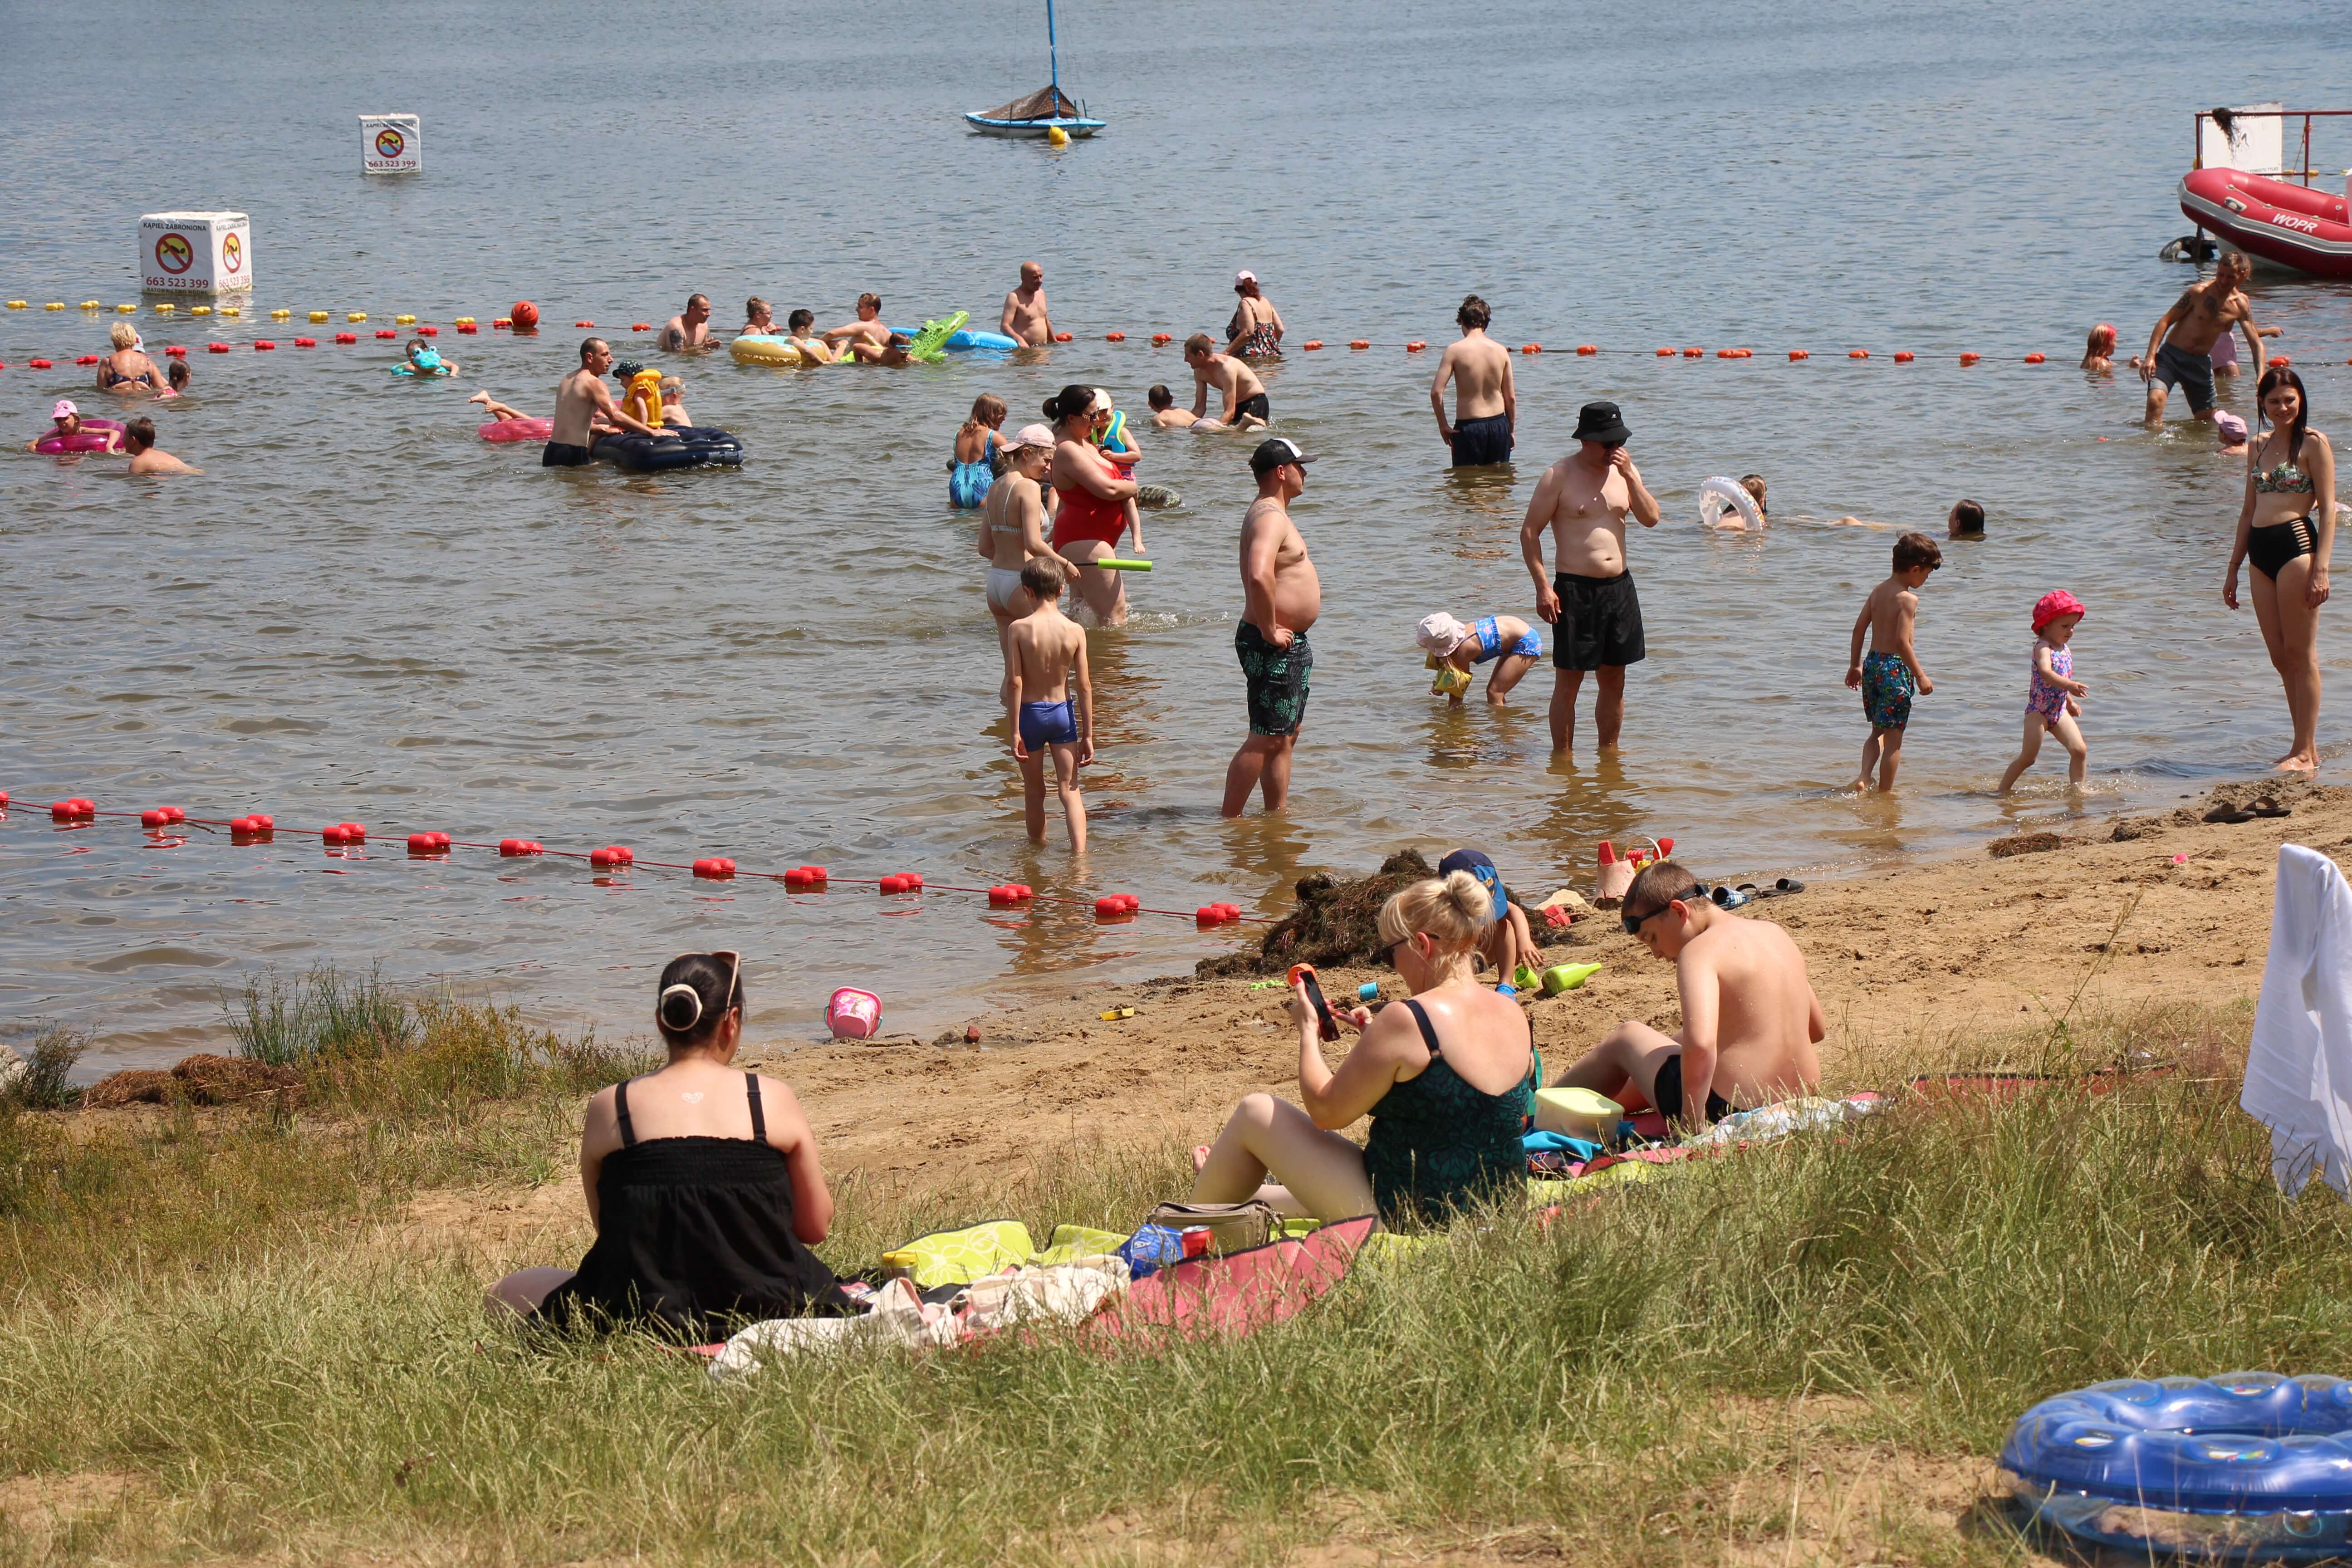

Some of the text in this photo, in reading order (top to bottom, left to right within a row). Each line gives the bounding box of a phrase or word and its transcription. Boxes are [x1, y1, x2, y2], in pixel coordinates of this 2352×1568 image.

[2272, 213, 2318, 233] WOPR
[147, 276, 209, 288] 663 523 399
[219, 274, 250, 288] 663 523 399
